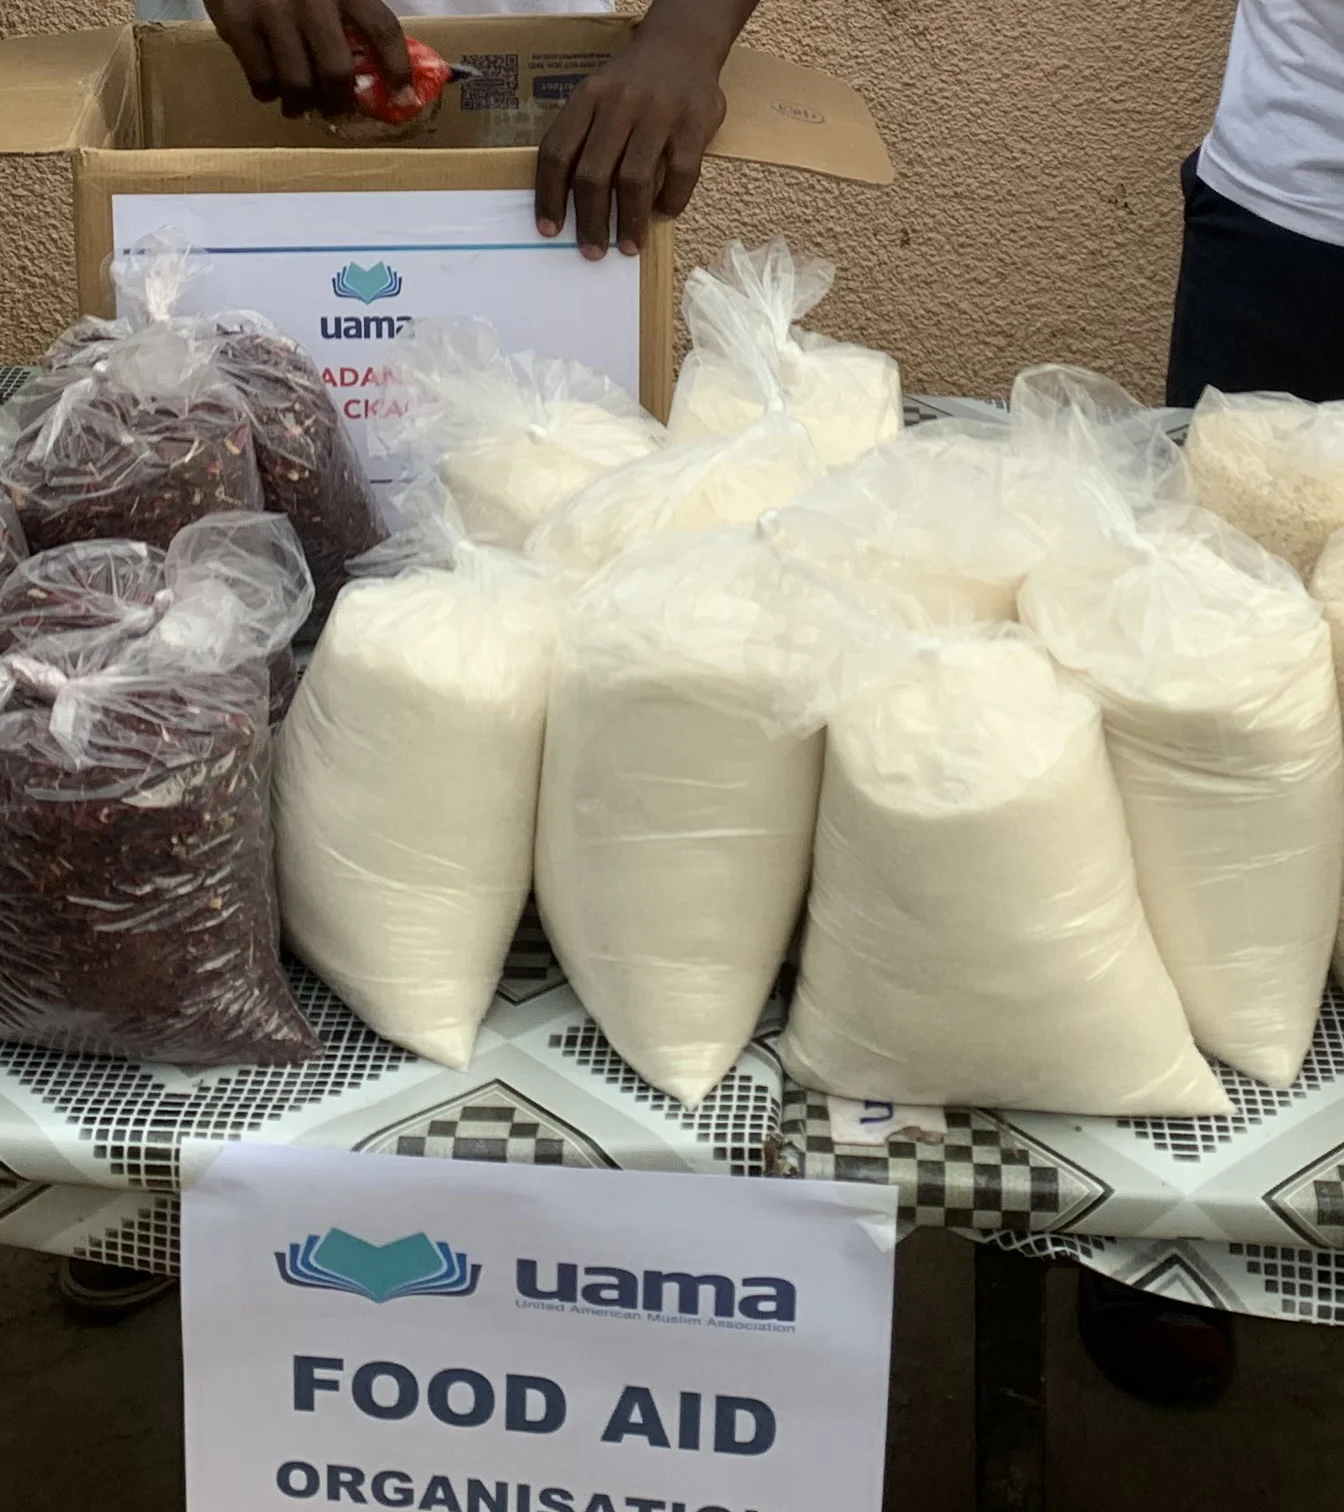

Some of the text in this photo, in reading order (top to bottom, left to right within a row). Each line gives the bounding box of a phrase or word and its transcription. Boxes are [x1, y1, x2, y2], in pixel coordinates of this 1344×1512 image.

[515, 1299, 796, 1334] United American Muslim Association
[516, 1258, 796, 1322] uama
[292, 1355, 777, 1456] FOOD AID
